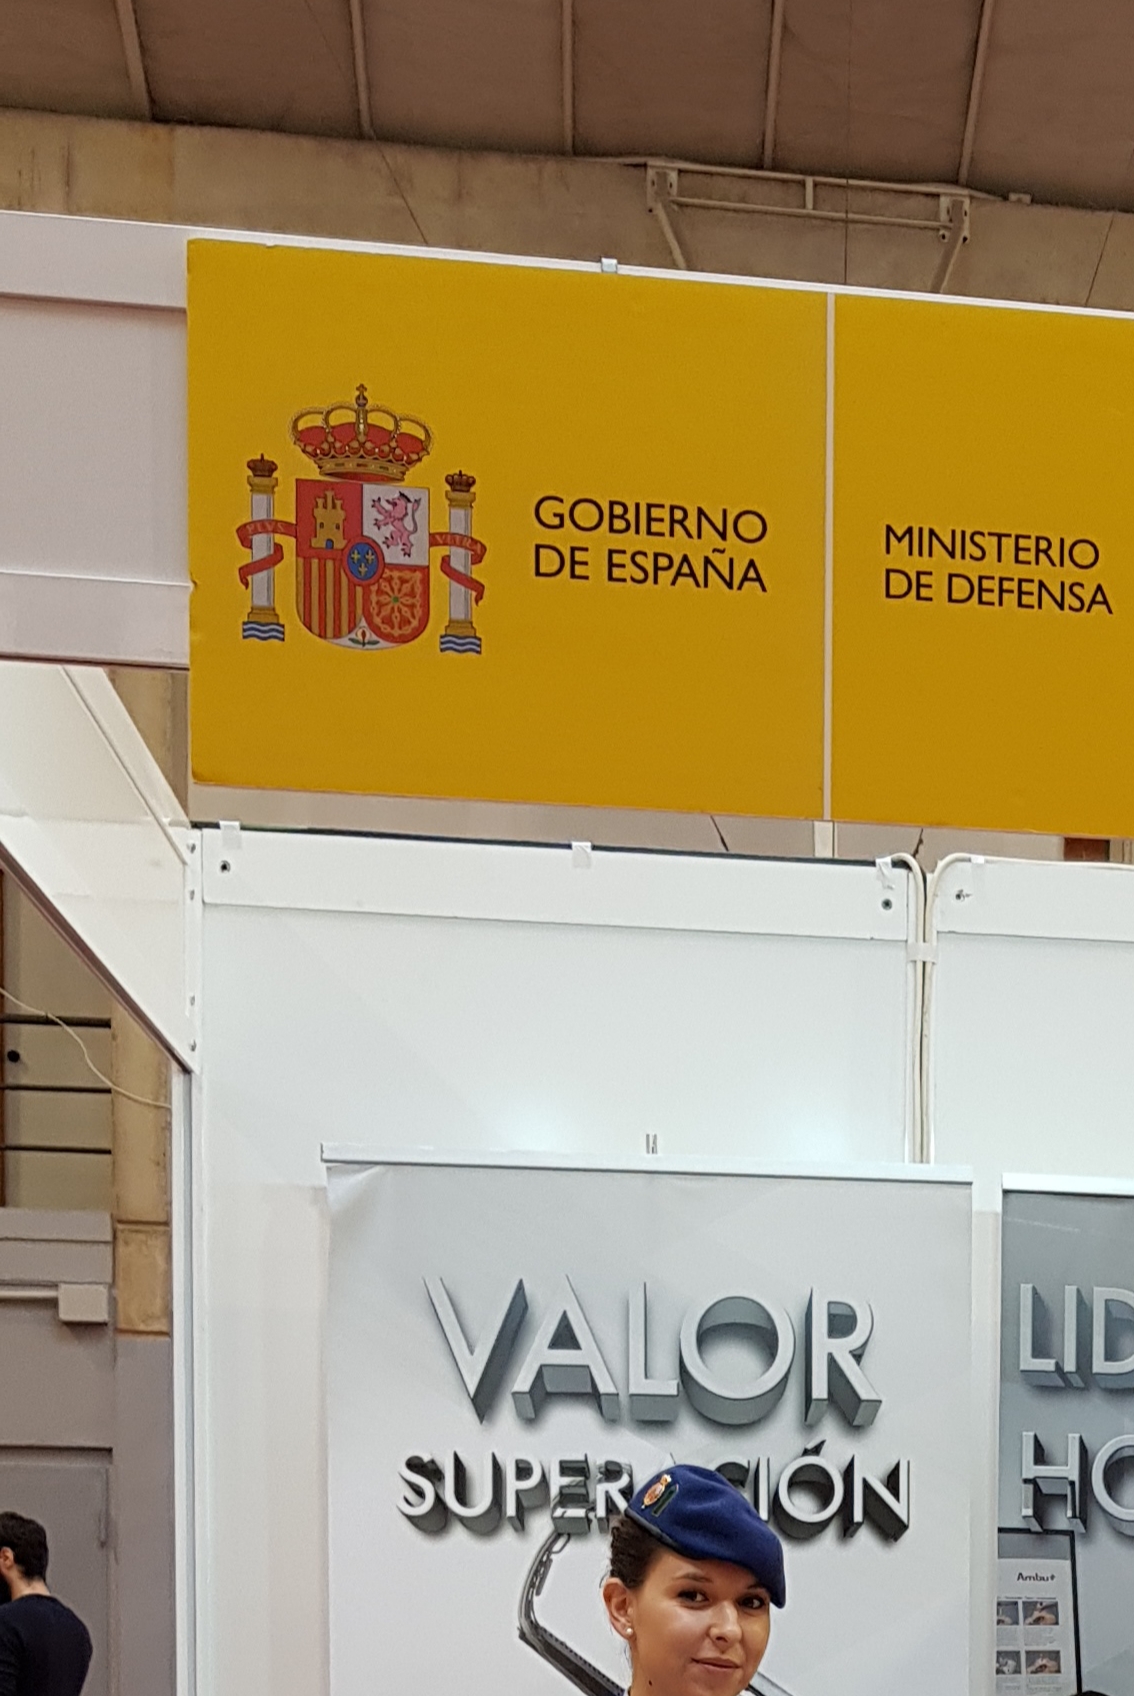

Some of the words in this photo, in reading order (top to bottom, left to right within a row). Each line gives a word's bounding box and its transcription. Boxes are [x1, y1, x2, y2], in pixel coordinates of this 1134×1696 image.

[533, 495, 768, 544] GOBIERNO
[533, 544, 590, 581] DE
[606, 548, 768, 593] ESPAÑA
[885, 524, 1100, 570] MINISTERIO
[884, 568, 934, 602] DE
[947, 573, 1114, 615] DEFENSA
[422, 1274, 882, 1425] VALOR
[396, 1439, 911, 1544] SUPERIÓN
